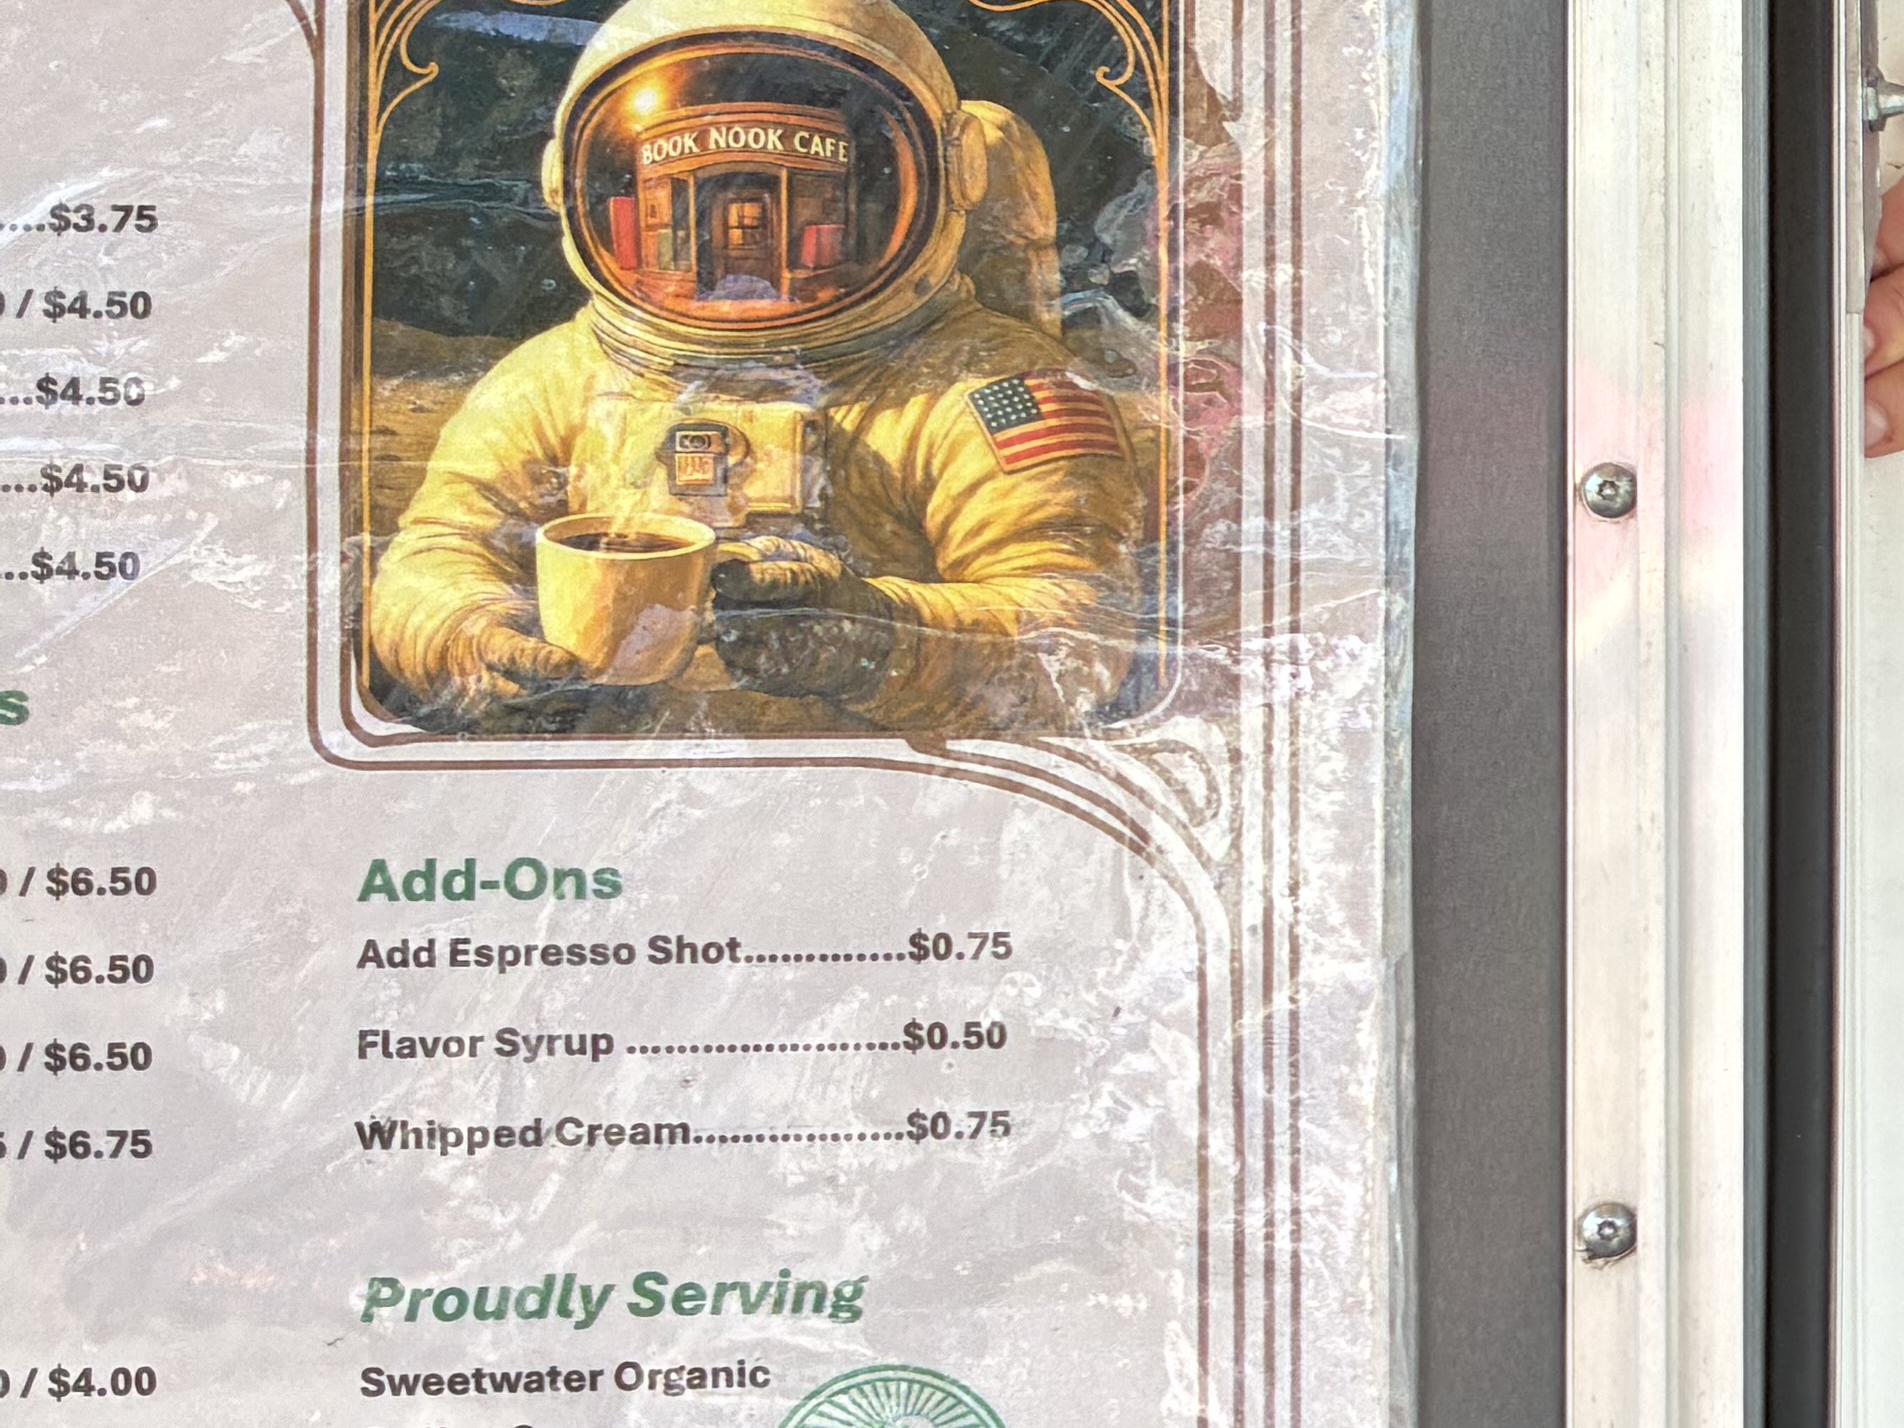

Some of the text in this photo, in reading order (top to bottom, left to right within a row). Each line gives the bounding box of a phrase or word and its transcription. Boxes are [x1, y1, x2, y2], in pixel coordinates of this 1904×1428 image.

[641, 125, 850, 166] BOOK NOOK CAFE
[43, 286, 153, 323] $4.50
[46, 862, 157, 901] $6.50
[357, 857, 624, 902] Add-Ons
[45, 951, 154, 989] $6.50
[357, 938, 436, 969] Add
[449, 936, 636, 973] Espresso
[44, 1038, 152, 1076] $6.50
[357, 1028, 484, 1059] Flavor
[494, 1026, 615, 1063] Syrup
[44, 1126, 153, 1164] $6.75
[355, 1115, 543, 1154] Whipped
[360, 1268, 870, 1330] Proudly Serving
[48, 1363, 157, 1399] $4.00
[360, 1359, 771, 1398] Sweetwater Organic
